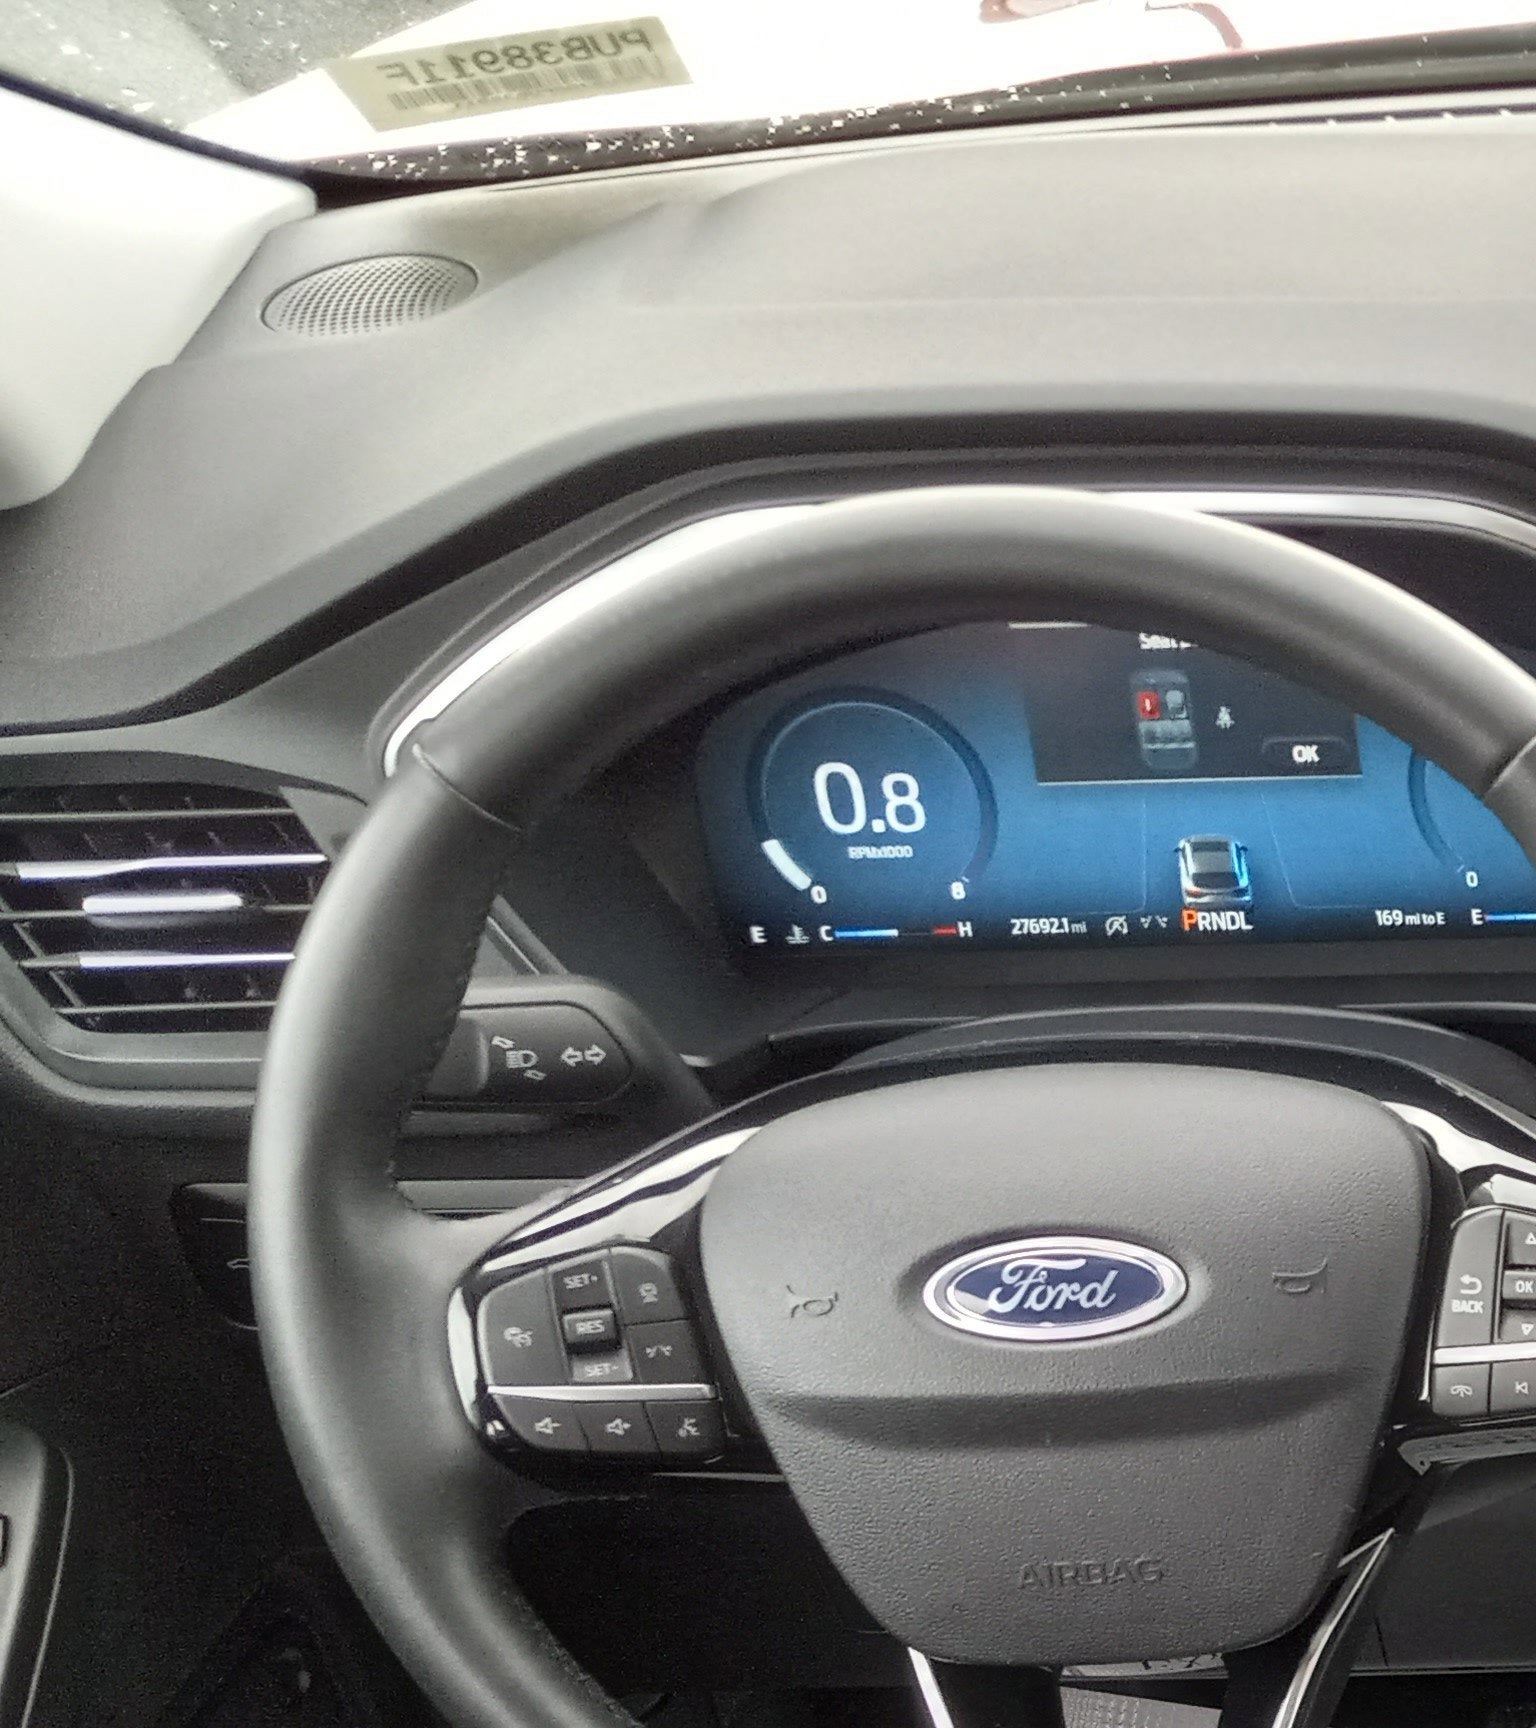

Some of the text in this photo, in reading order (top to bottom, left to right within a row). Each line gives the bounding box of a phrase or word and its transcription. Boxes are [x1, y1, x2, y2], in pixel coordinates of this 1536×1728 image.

[1292, 745, 1320, 763] OK
[813, 762, 926, 834] 0.8
[1466, 871, 1479, 887] 0
[811, 886, 827, 904] 0
[1182, 910, 1253, 932] PRNDL
[1375, 910, 1402, 925] 169
[1404, 912, 1420, 925] mi
[1472, 910, 1484, 925] E
[749, 926, 767, 943] E
[820, 926, 833, 942] C
[958, 922, 973, 938] H
[1071, 921, 1087, 933] mi
[988, 1257, 1118, 1312] Ford
[1516, 1281, 1533, 1293] OK
[1452, 1300, 1483, 1314] BACK
[576, 1321, 605, 1335] RES
[1017, 1558, 1166, 1588] AIRBAG
